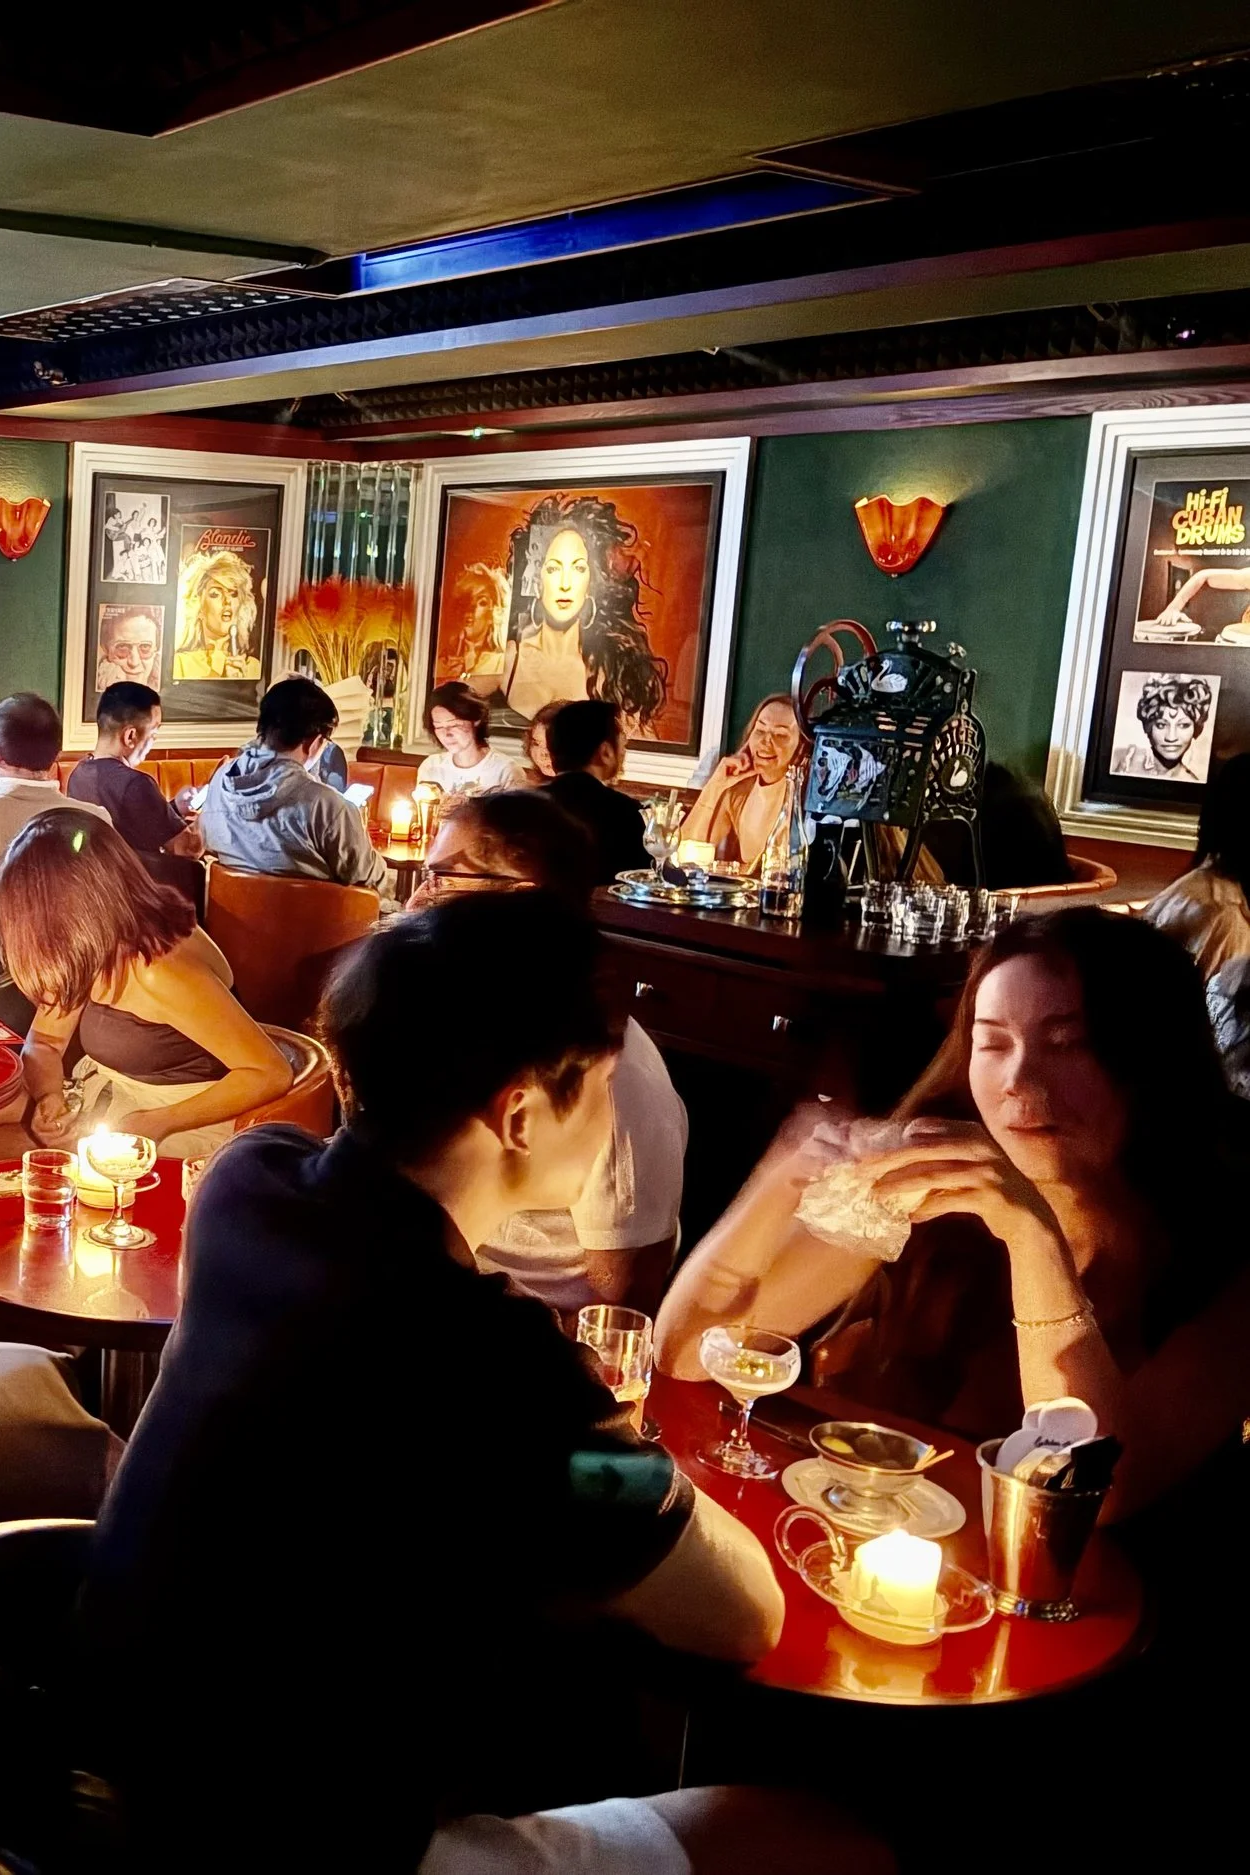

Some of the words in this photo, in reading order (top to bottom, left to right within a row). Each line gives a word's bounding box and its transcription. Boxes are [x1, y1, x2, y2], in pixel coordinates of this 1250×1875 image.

[1172, 505, 1243, 531] CUBAN
[194, 528, 257, 552] Blondie
[1175, 524, 1245, 545] DRUMS
